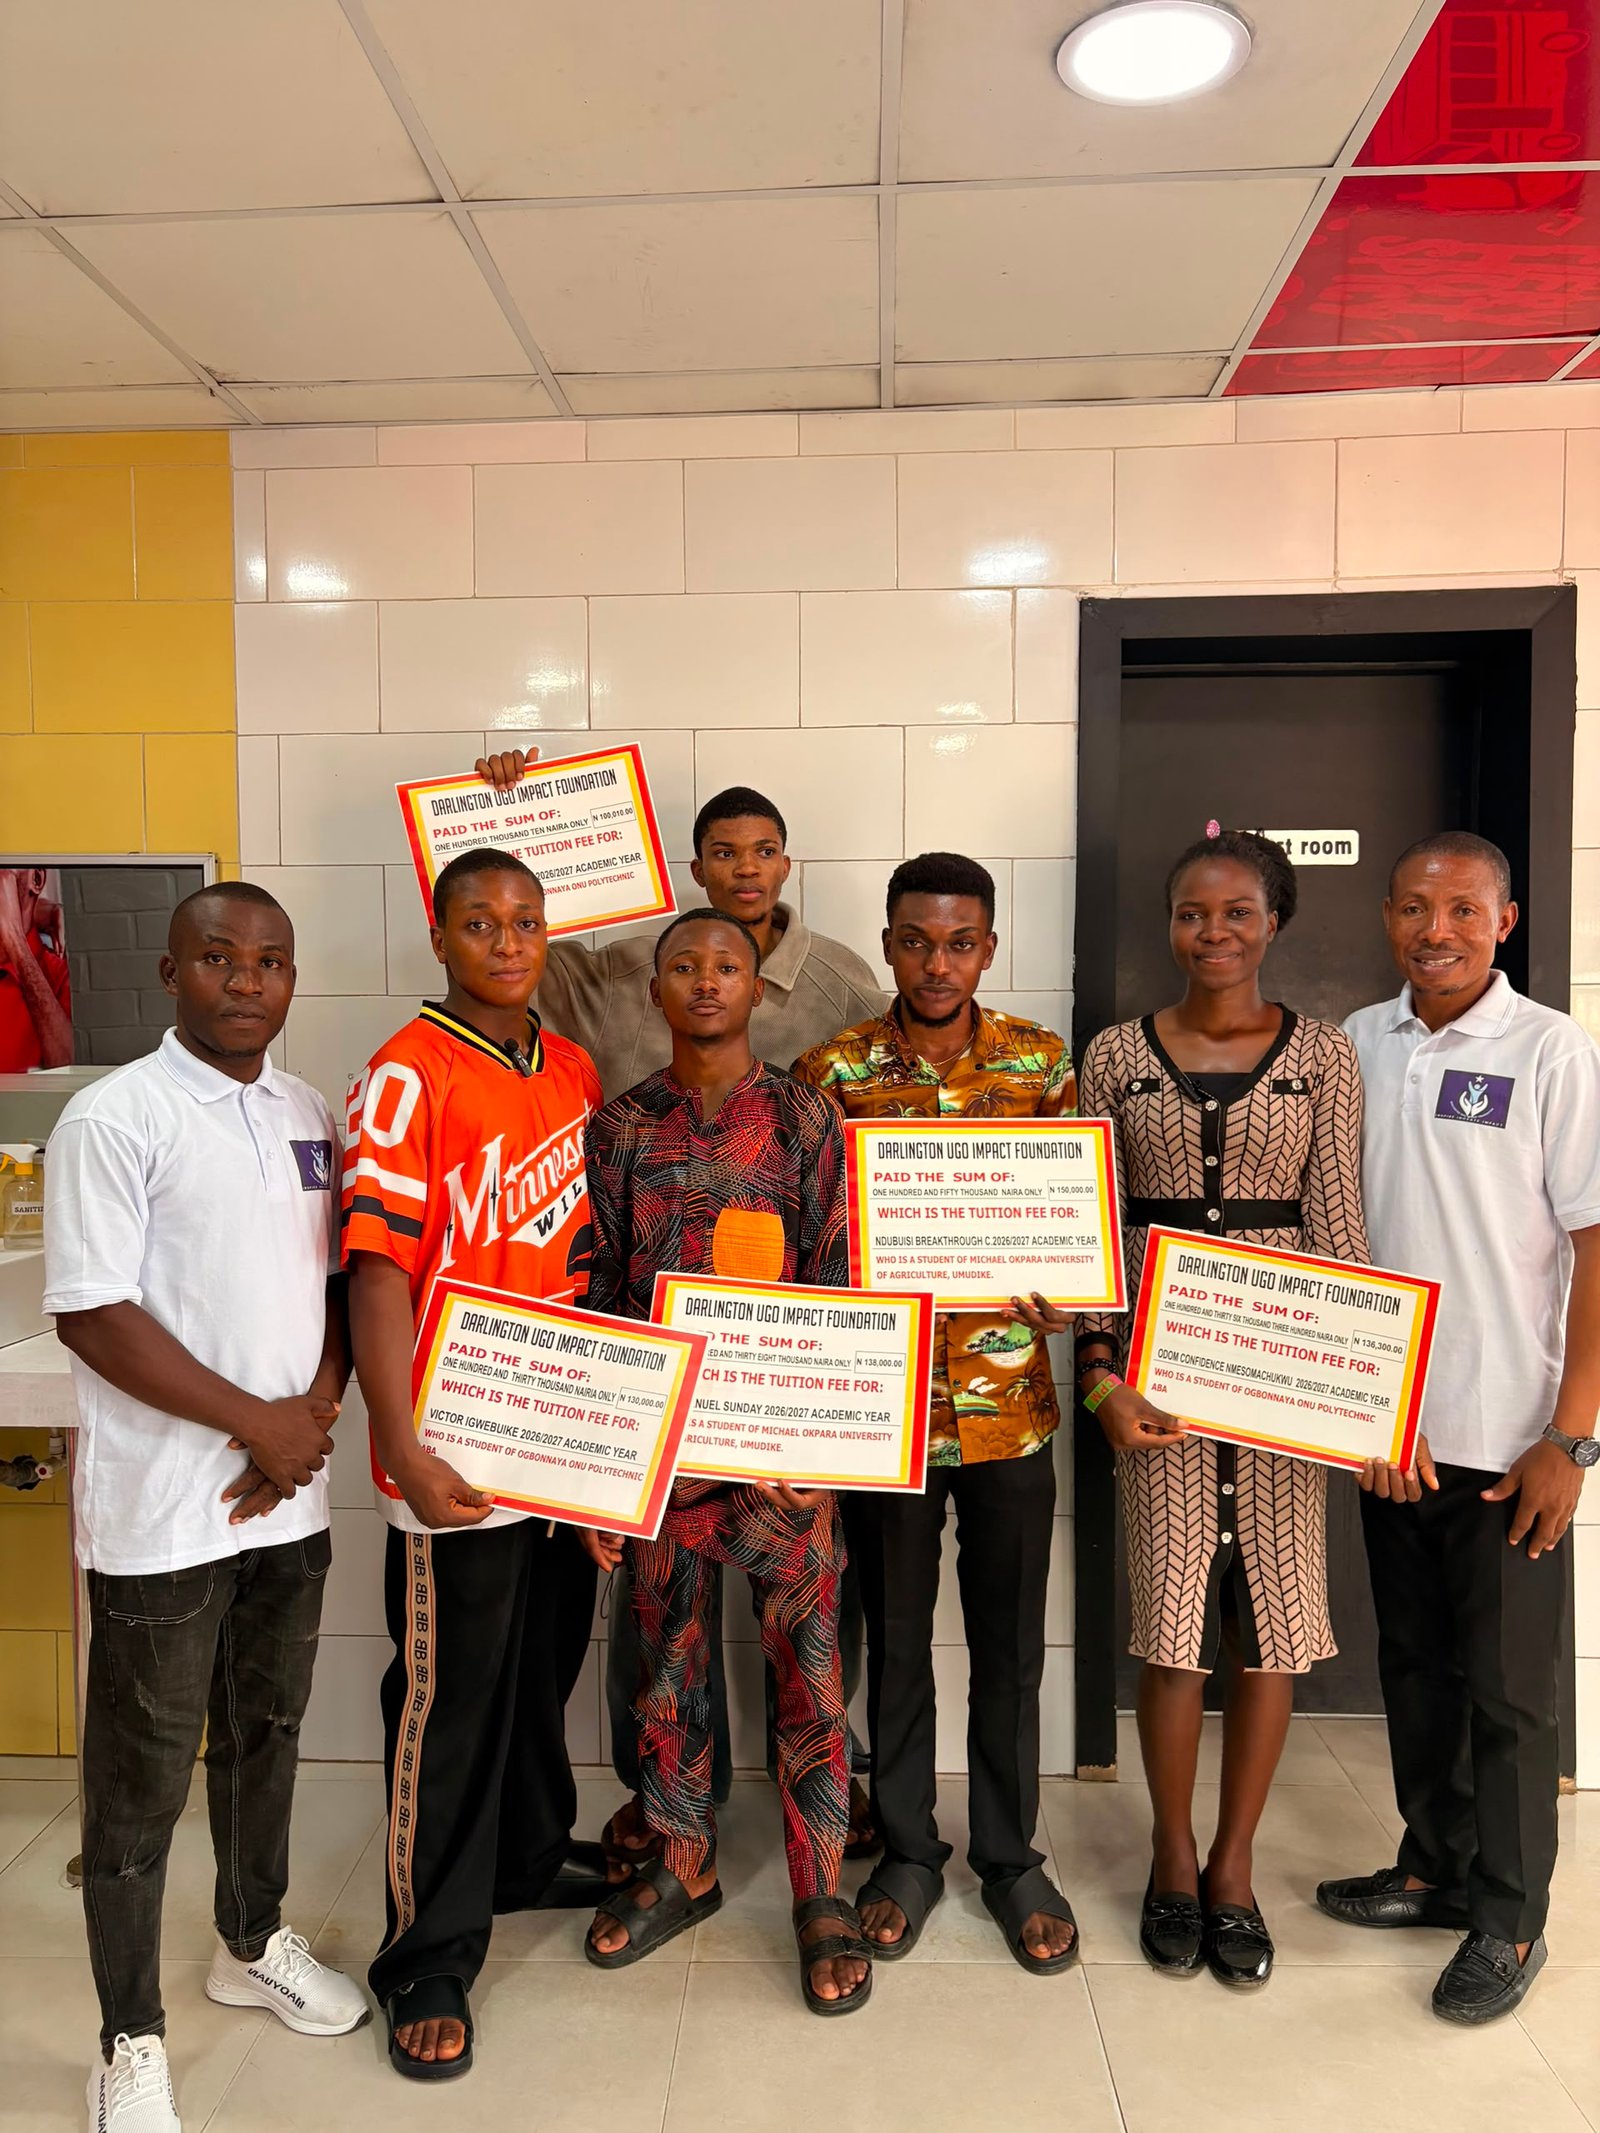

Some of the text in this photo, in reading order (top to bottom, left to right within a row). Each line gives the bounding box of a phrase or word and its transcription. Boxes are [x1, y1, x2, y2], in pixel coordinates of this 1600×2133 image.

[431, 769, 617, 816] DARLINGTON UGO IMPACT FOUNDATION
[433, 809, 561, 838] PAID THE SUM OF:
[600, 808, 633, 820] 100,010.00
[435, 818, 588, 852] ONE HUNDRED THOUSAND TEN NAIRA ONLY
[1301, 841, 1352, 855] room
[535, 852, 642, 881] 2026/2027 ACADEMIC YEAR
[344, 1061, 422, 1152] 20
[878, 1142, 1082, 1159] DARLINGTON UGO IMPACT FOUNDATION
[874, 1172, 1014, 1182] PAID THE SUM OF:
[1057, 1186, 1094, 1194] 150,000.00
[873, 1188, 887, 1196] ONE
[889, 1188, 923, 1196] HUNDRED
[533, 1181, 583, 1238] WIL
[877, 1207, 1079, 1219] WHICH IS THE TUITION FEE FOR:
[915, 1236, 983, 1246] BREAKTHROUGH
[1032, 1236, 1073, 1245] ACADEMIC
[1076, 1236, 1097, 1245] YEAR
[876, 1256, 896, 1264] WHO
[899, 1256, 908, 1264] IS
[917, 1256, 955, 1264] STUDENT
[970, 1256, 1007, 1264] MICHAEL
[1008, 1255, 1042, 1263] OKPARA
[1044, 1255, 1094, 1263] UNIVERSITY
[877, 1271, 993, 1280] OF AGRICULTURE, UMUDIKE.
[1178, 1255, 1401, 1316] DARLINGTON UGO IMPACT FOUNDATION
[686, 1297, 896, 1331] DARLINGTON UGO IMPACT FOUNDATION
[1169, 1284, 1319, 1324] PAID THE SUM OF:
[461, 1312, 666, 1371] DARLINGTON UGO IMPACT FOUNDATION
[720, 1332, 750, 1345] THE
[759, 1336, 792, 1348] SUM
[797, 1339, 822, 1351] OF:
[1166, 1320, 1380, 1376] WHICH IS THE TUITION FEE FOR:
[1362, 1339, 1403, 1354] 136,300.00
[449, 1342, 591, 1382] PAID THE SUM OF:
[865, 1358, 902, 1367] 138,000.00
[443, 1356, 616, 1401] ONE HUNDRED AND THIRTY THOUSAND NAIRIA ONLY
[723, 1370, 737, 1383] IS
[741, 1372, 765, 1385] THE
[769, 1374, 824, 1390] TUITION
[828, 1378, 850, 1391] FEE
[854, 1380, 883, 1393] FOR:
[1151, 1383, 1167, 1393] ABA
[1158, 1348, 1390, 1408] ODOM CONFIDENCE NMESOMACHUKWU 2026/2027 ACADEMIC YEAR
[442, 1379, 639, 1431] WHICH IS THE TUITION FEE FOR:
[628, 1396, 664, 1409] 130,000.00
[1155, 1367, 1376, 1423] WHO IS A STUDENT OF OGBONNAYA ONU POLYTECHNIC
[724, 1401, 762, 1414] SUNDAY
[765, 1405, 809, 1417] 2026/2027
[810, 1409, 861, 1420] ACADEMIC
[865, 1412, 890, 1424] YEAR
[431, 1408, 637, 1460] VICTOR IGWEBUIKE 2026/2027 ACADEMIC YEAR
[424, 1428, 644, 1481] WHO IS A STUDENT OF OGBONNAYA ONU POLYTECHNIC
